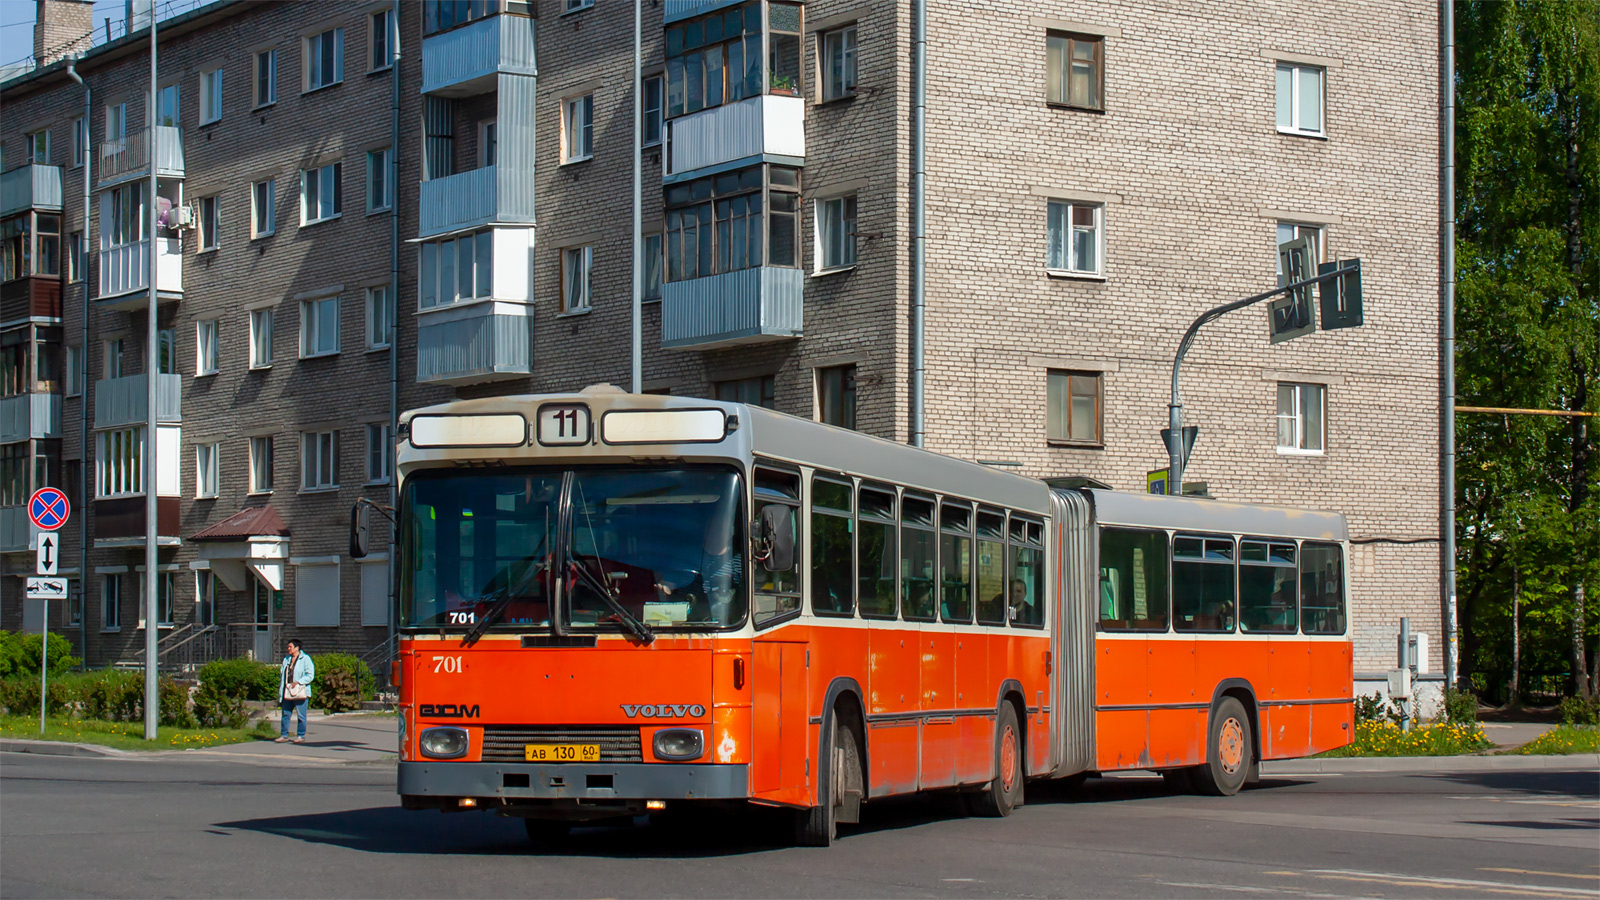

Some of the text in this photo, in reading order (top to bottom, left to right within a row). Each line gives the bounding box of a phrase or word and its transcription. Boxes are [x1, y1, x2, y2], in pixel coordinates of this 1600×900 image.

[552, 409, 578, 438] 11
[449, 611, 475, 624] 701
[432, 655, 463, 674] 701
[620, 704, 706, 718] VOLVO
[531, 746, 595, 760] AB 130 60
